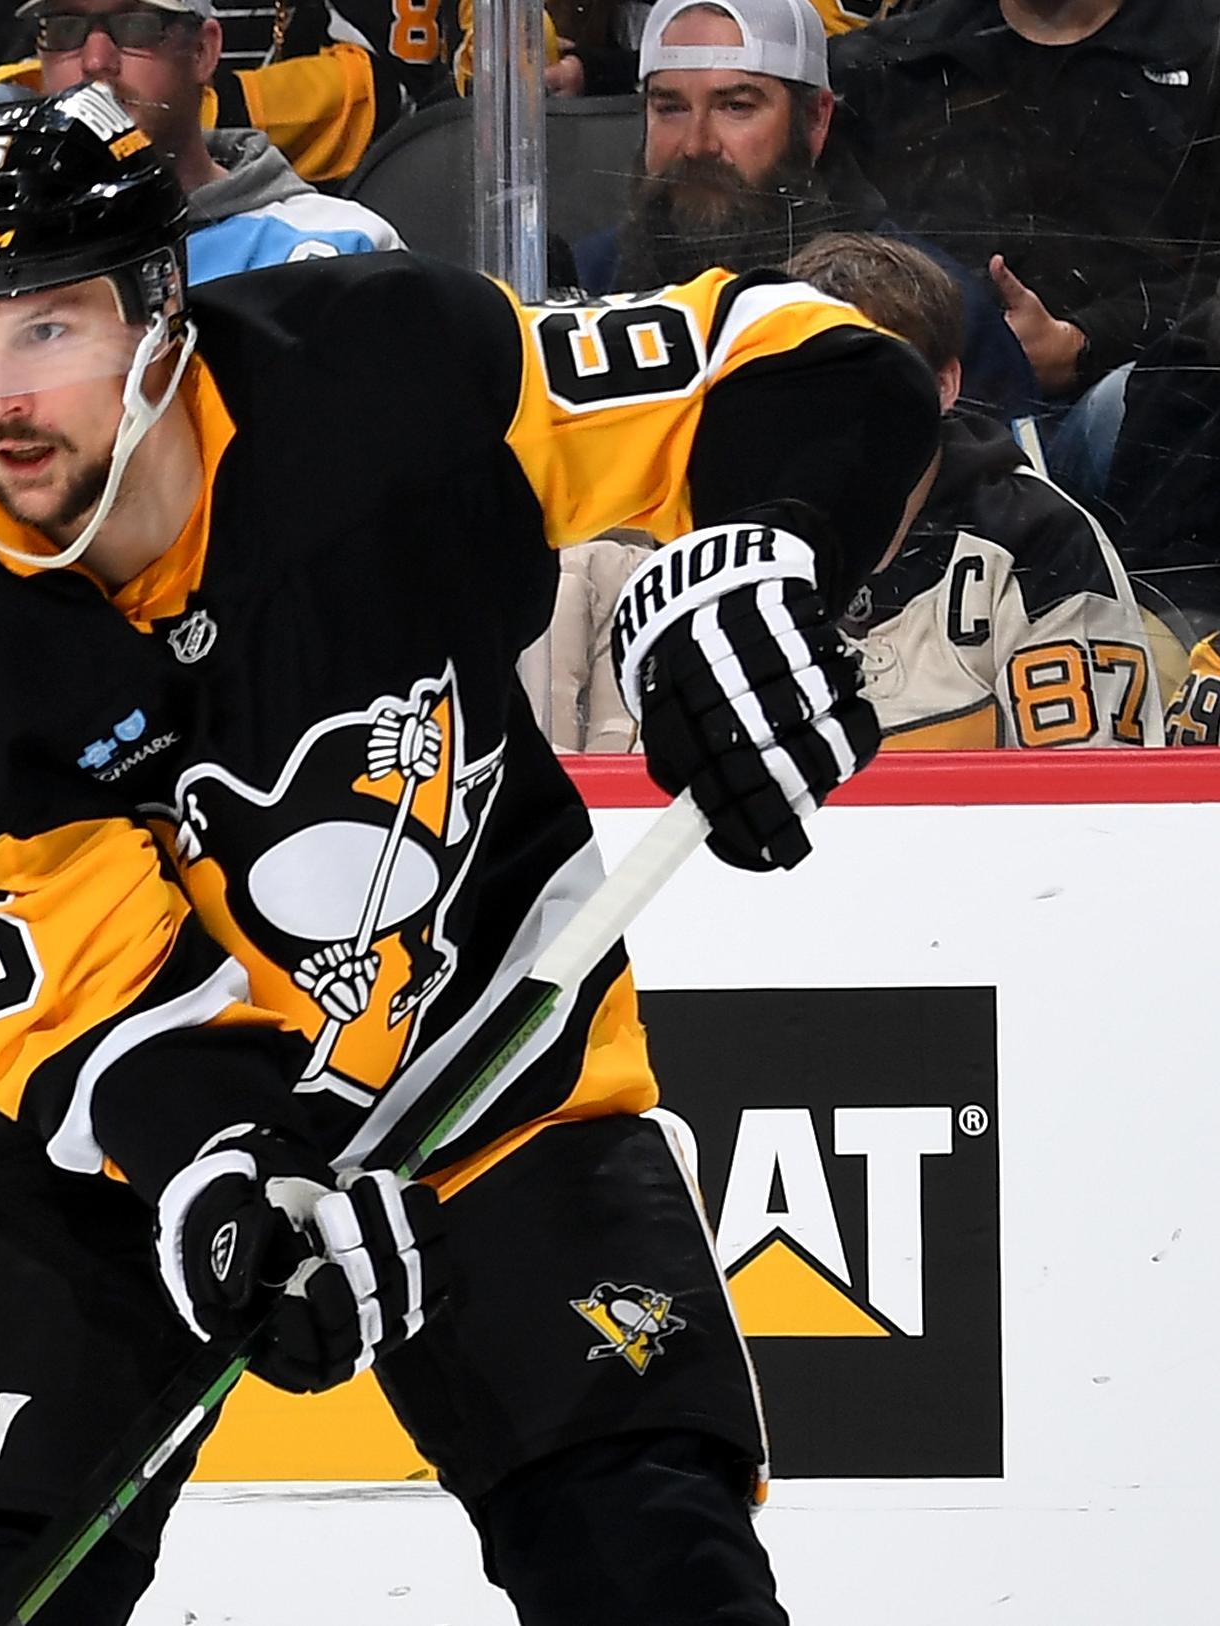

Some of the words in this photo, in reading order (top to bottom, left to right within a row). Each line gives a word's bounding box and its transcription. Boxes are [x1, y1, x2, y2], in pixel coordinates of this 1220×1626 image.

[389, 0, 449, 64] 8
[531, 284, 706, 415] 6
[611, 527, 777, 668] RRIOR
[947, 554, 991, 646] C
[1012, 638, 1149, 749] 87
[93, 730, 181, 782] GHMARK
[638, 1106, 953, 1337] AT
